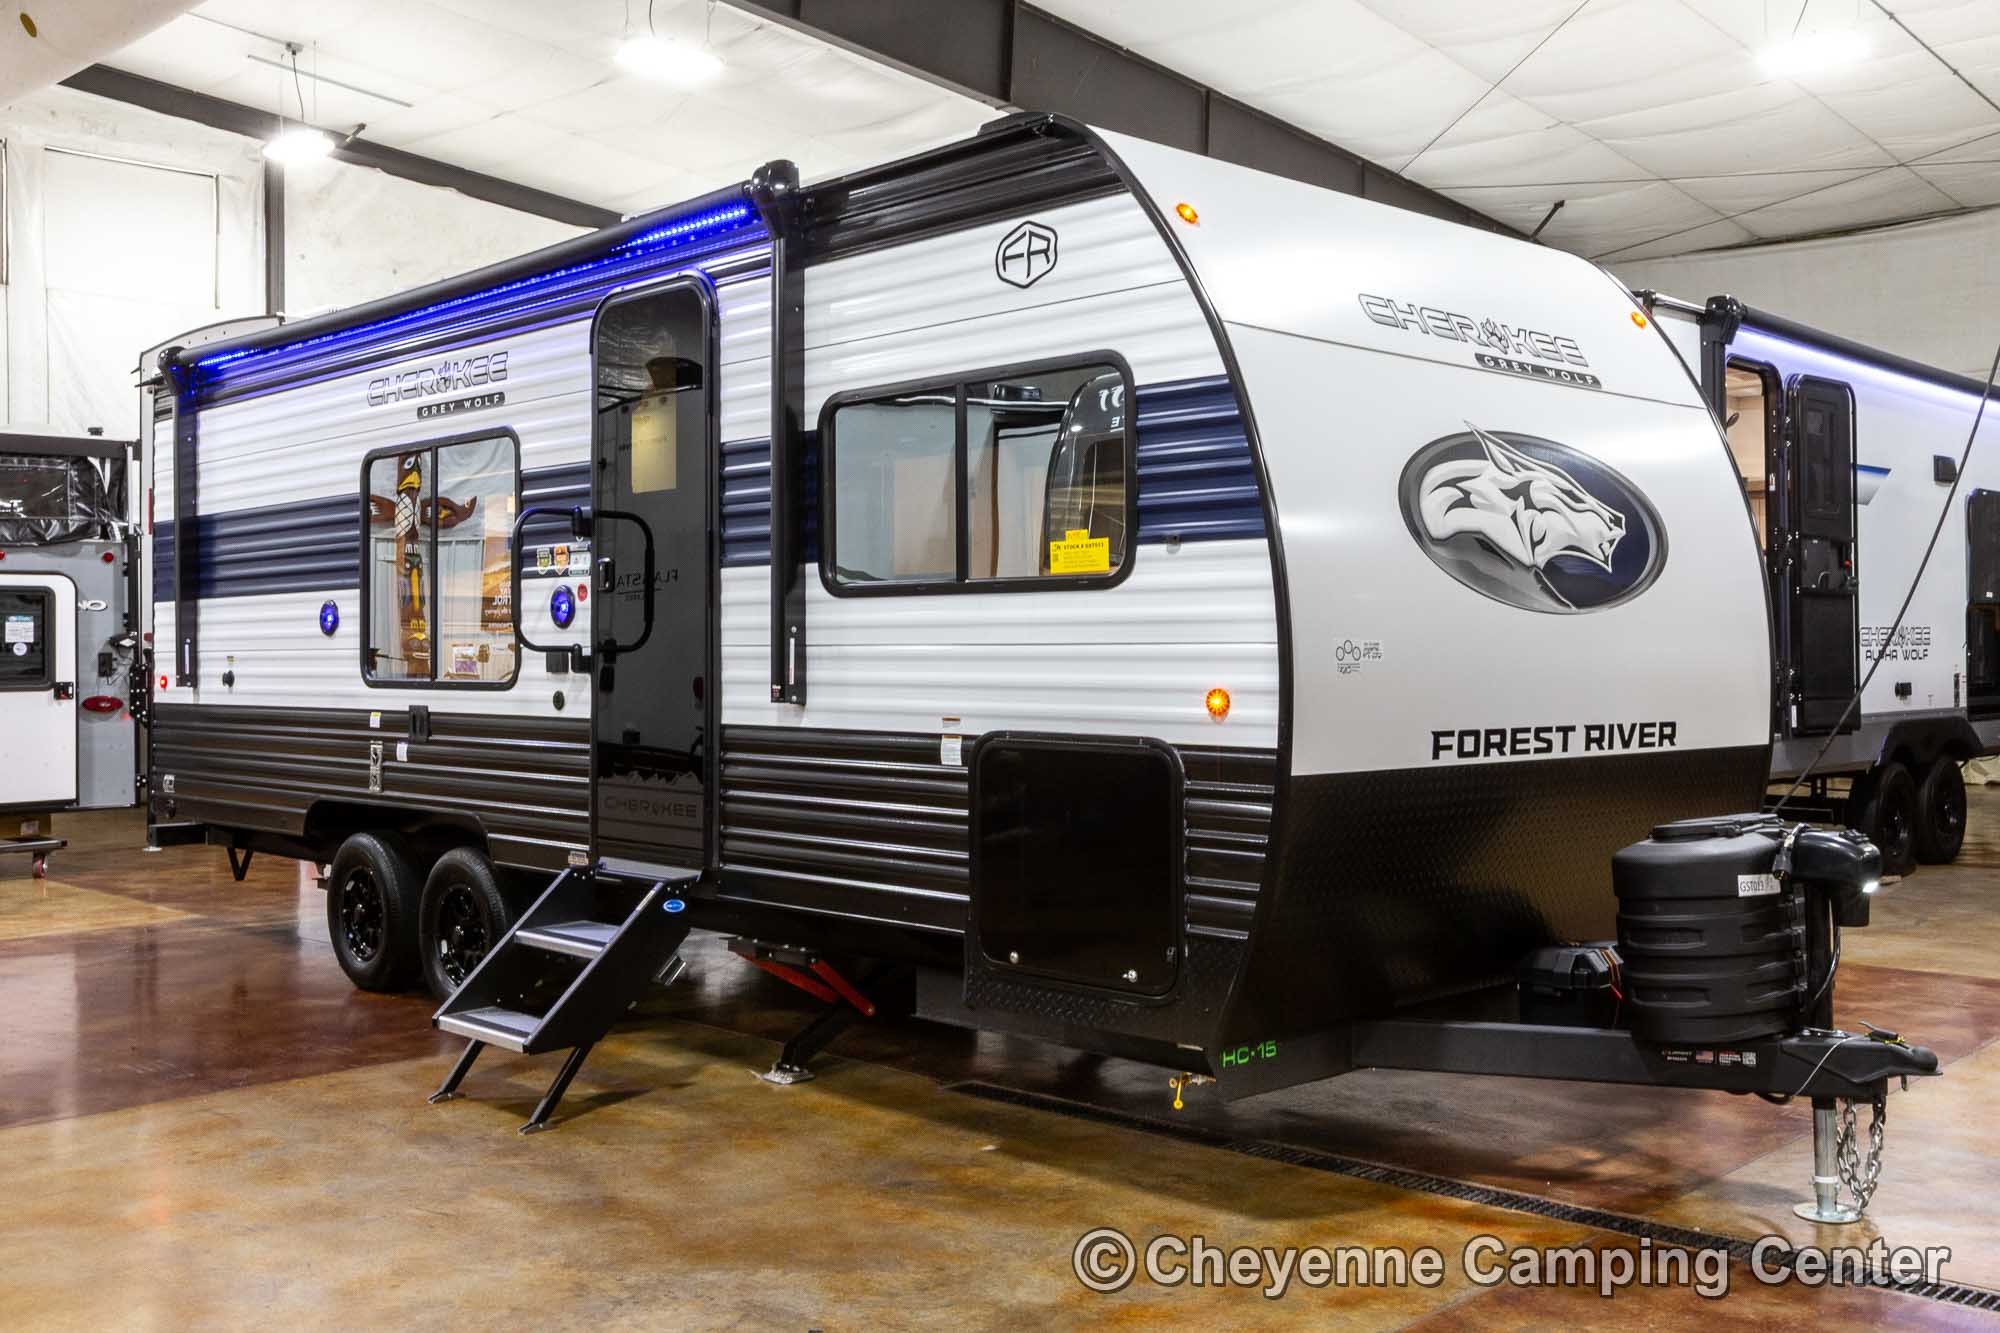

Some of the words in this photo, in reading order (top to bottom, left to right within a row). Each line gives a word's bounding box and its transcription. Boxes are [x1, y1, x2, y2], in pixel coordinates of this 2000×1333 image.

[1484, 356, 1534, 375] GREY
[1543, 366, 1595, 386] WOLF
[421, 403, 455, 417] GREY
[463, 395, 500, 409] WOLF
[1902, 648, 1929, 661] WOLF
[1431, 725, 1577, 760] FOREST
[1584, 721, 1677, 751] RIVER
